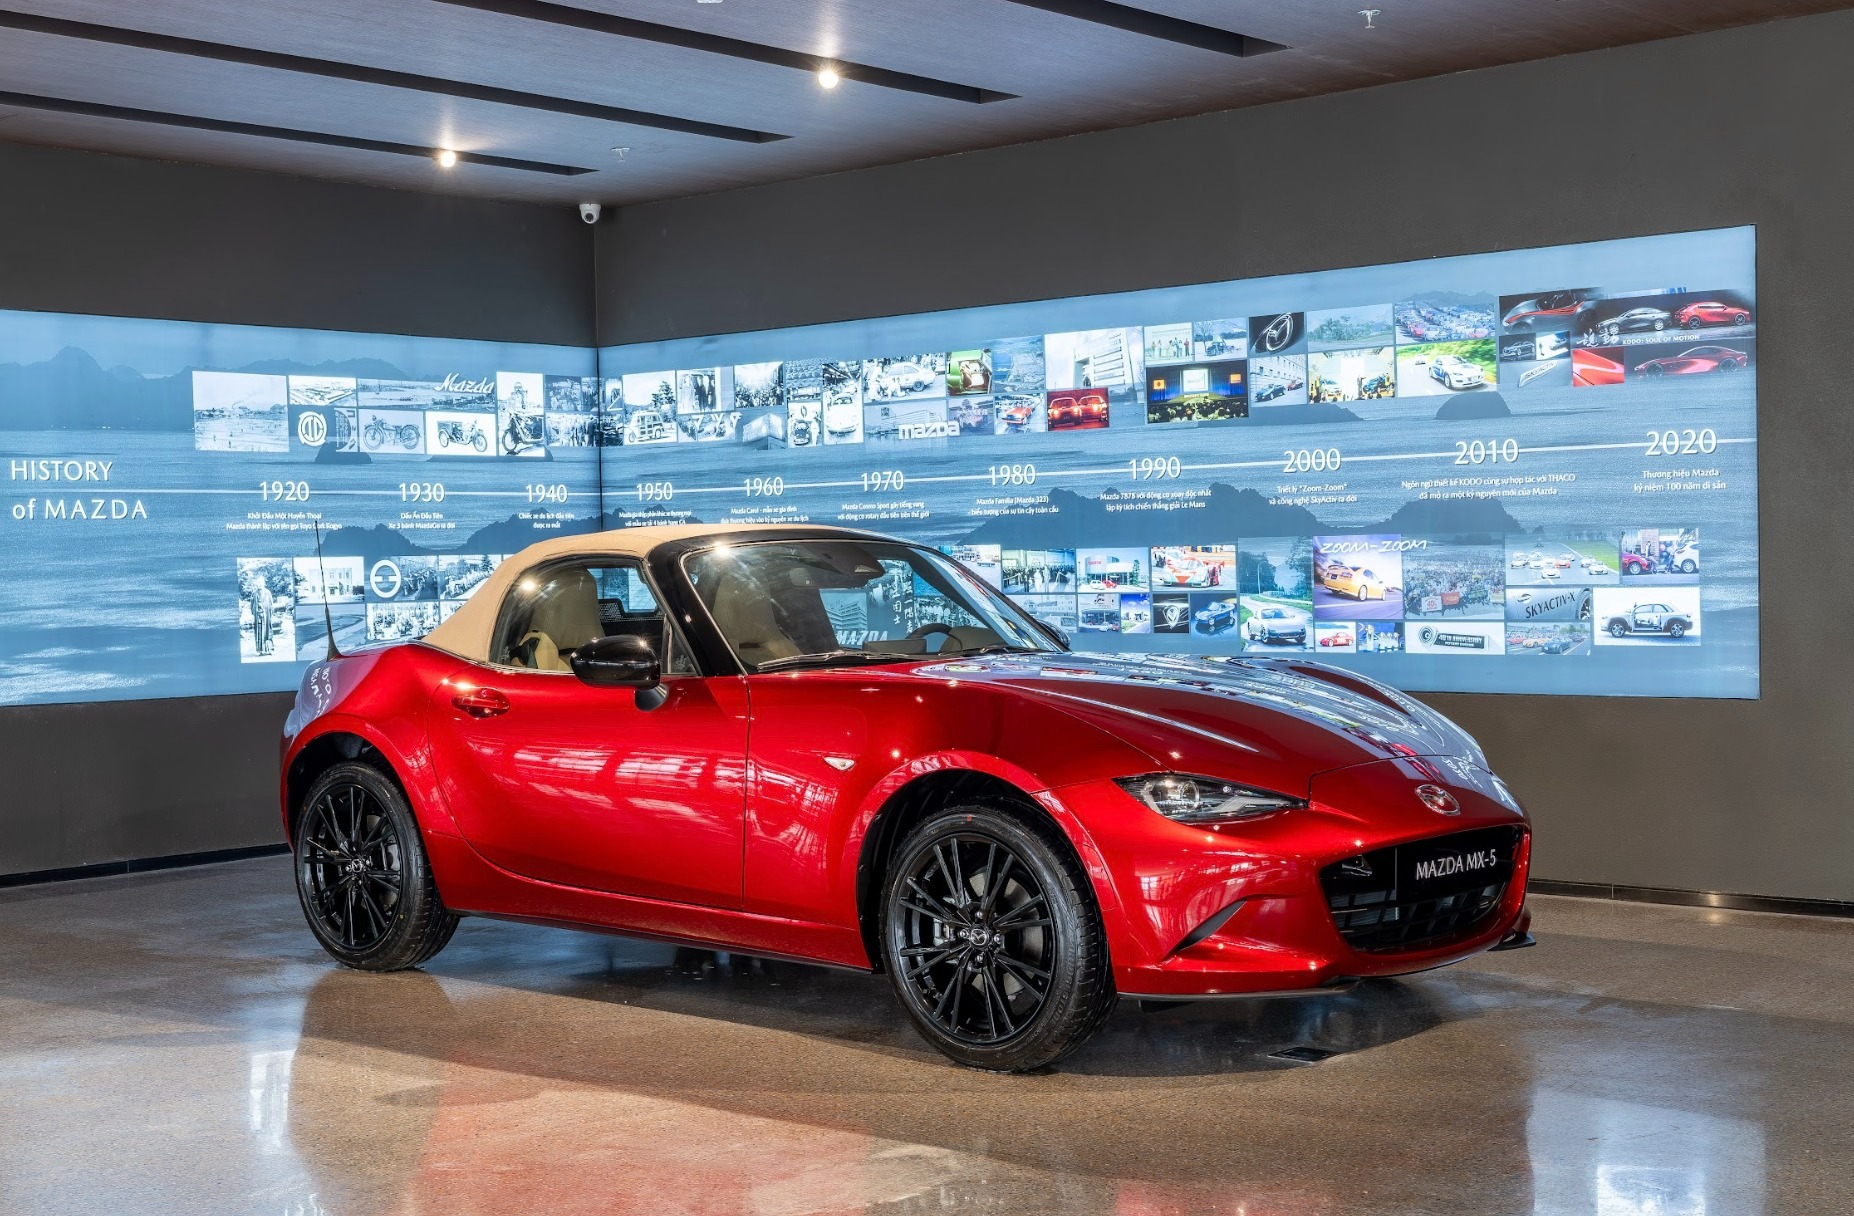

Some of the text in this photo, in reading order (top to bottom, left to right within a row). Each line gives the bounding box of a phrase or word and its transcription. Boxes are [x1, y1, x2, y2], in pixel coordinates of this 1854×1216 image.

[434, 373, 495, 394] Mazda
[1454, 438, 1519, 465] 2010
[1645, 428, 1717, 456] 2020
[11, 460, 113, 481] HISTORY
[1129, 456, 1181, 480] 1990
[1283, 448, 1341, 473] 2000
[861, 470, 904, 491] 1970
[989, 464, 1036, 485] 1980
[1459, 477, 1482, 486] KODO
[1548, 473, 1576, 482] THACO
[1642, 468, 1719, 479] Thương hiệu Mazda
[260, 481, 310, 501] 1920
[399, 482, 445, 502] 1930
[526, 484, 568, 503] 1940
[637, 482, 673, 501] 1950
[744, 477, 784, 497] 1960
[1532, 486, 1558, 496] Mazda
[1667, 482, 1680, 490] 100
[1683, 482, 1700, 490] năm
[1702, 481, 1710, 489] di
[12, 498, 148, 520] of MAZDA
[1526, 591, 1576, 619] SKYACTIV-X
[1416, 849, 1496, 880] MAZDA MX-5
